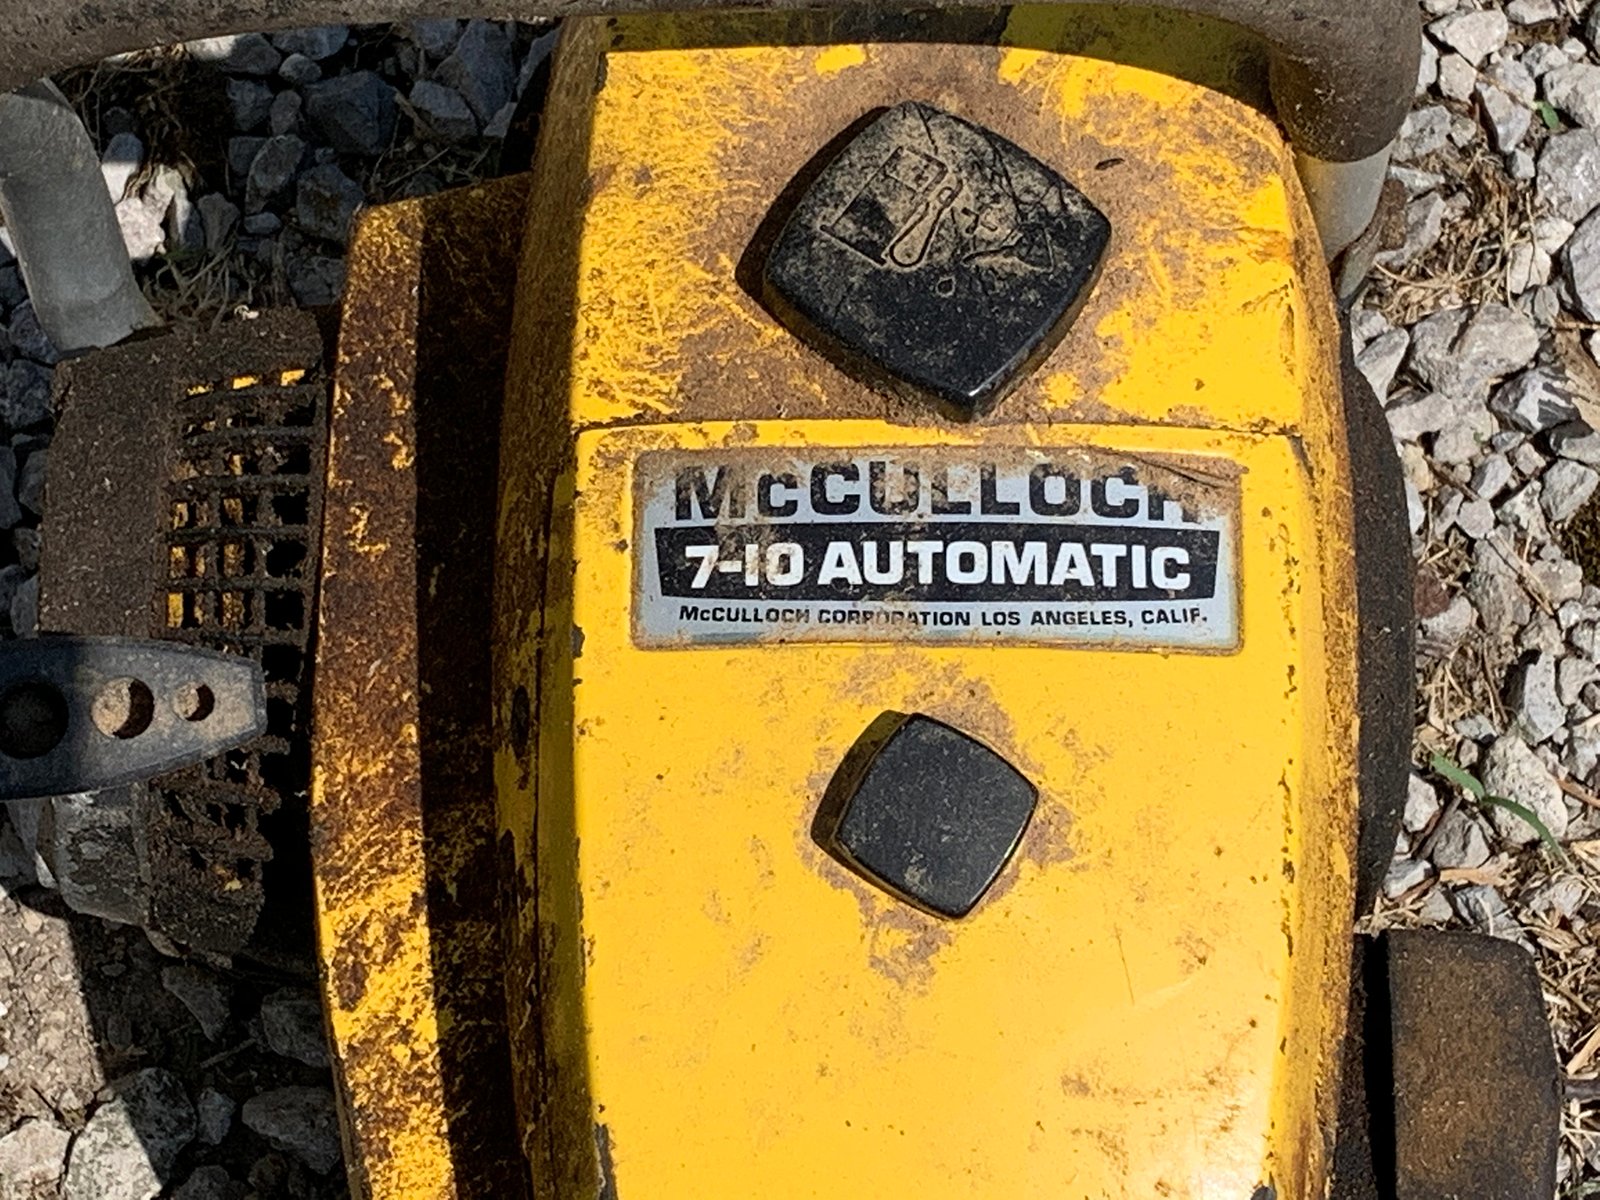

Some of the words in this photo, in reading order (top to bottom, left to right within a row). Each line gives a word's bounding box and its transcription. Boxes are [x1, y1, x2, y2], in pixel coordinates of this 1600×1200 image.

[685, 541, 805, 590] 7-10
[816, 540, 1191, 591] AUTOMATIC
[678, 605, 810, 624] McCULLOCH
[981, 610, 1021, 626] LOS
[1030, 610, 1134, 628] ANGELES,
[1141, 607, 1208, 625] CALIF.
